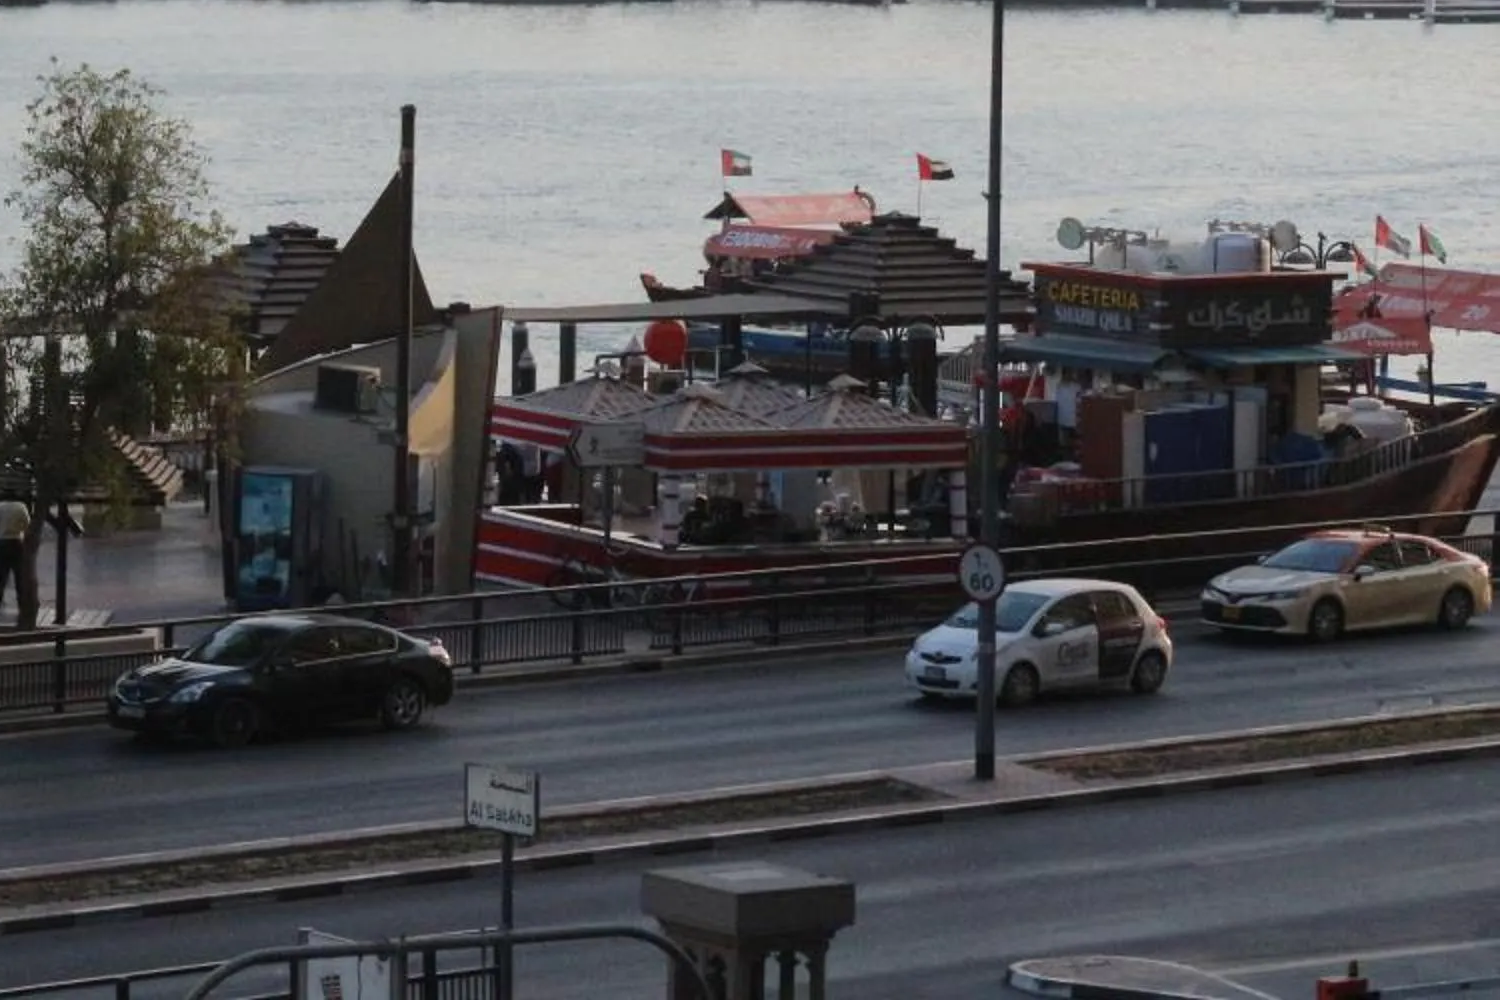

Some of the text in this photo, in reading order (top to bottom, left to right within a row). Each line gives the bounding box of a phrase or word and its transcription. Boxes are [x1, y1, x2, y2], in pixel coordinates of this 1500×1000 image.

[1047, 280, 1139, 311] CAFETERIA
[969, 572, 994, 592] 60
[470, 799, 483, 819] Al
